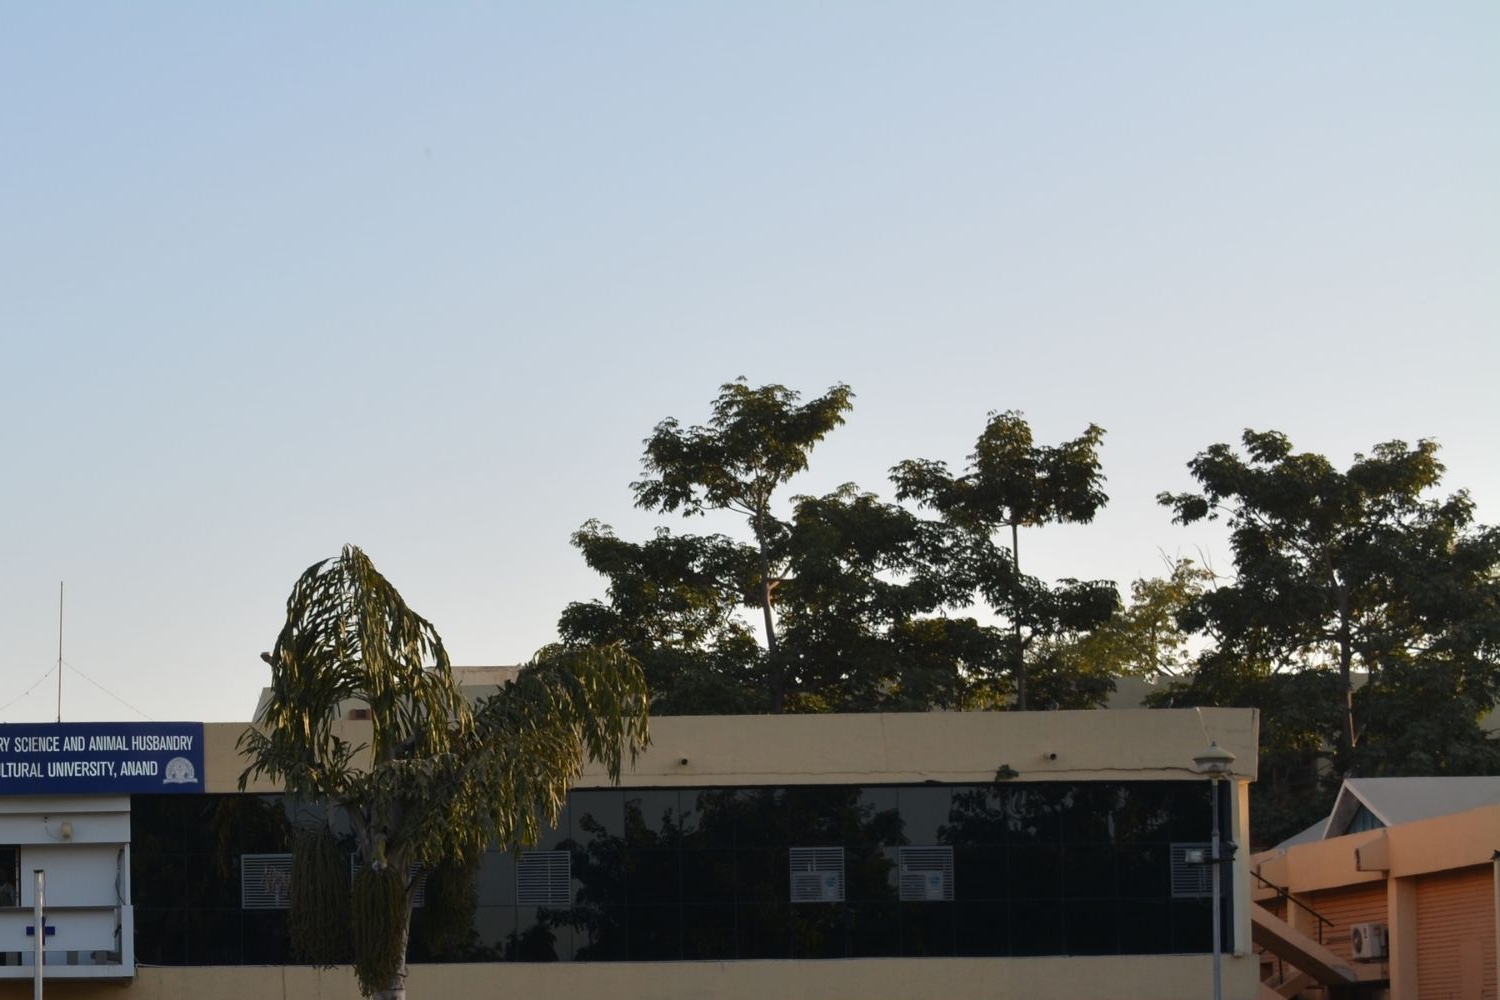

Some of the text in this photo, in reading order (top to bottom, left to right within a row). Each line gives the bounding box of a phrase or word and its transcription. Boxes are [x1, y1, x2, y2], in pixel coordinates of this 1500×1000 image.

[14, 736, 60, 753] SCIENCE
[63, 736, 86, 752] AND
[88, 735, 129, 751] ANIMAL
[131, 735, 193, 751] HUSBANDRY
[47, 761, 118, 778] UNIVERSITY,
[120, 760, 158, 777] ANAND
